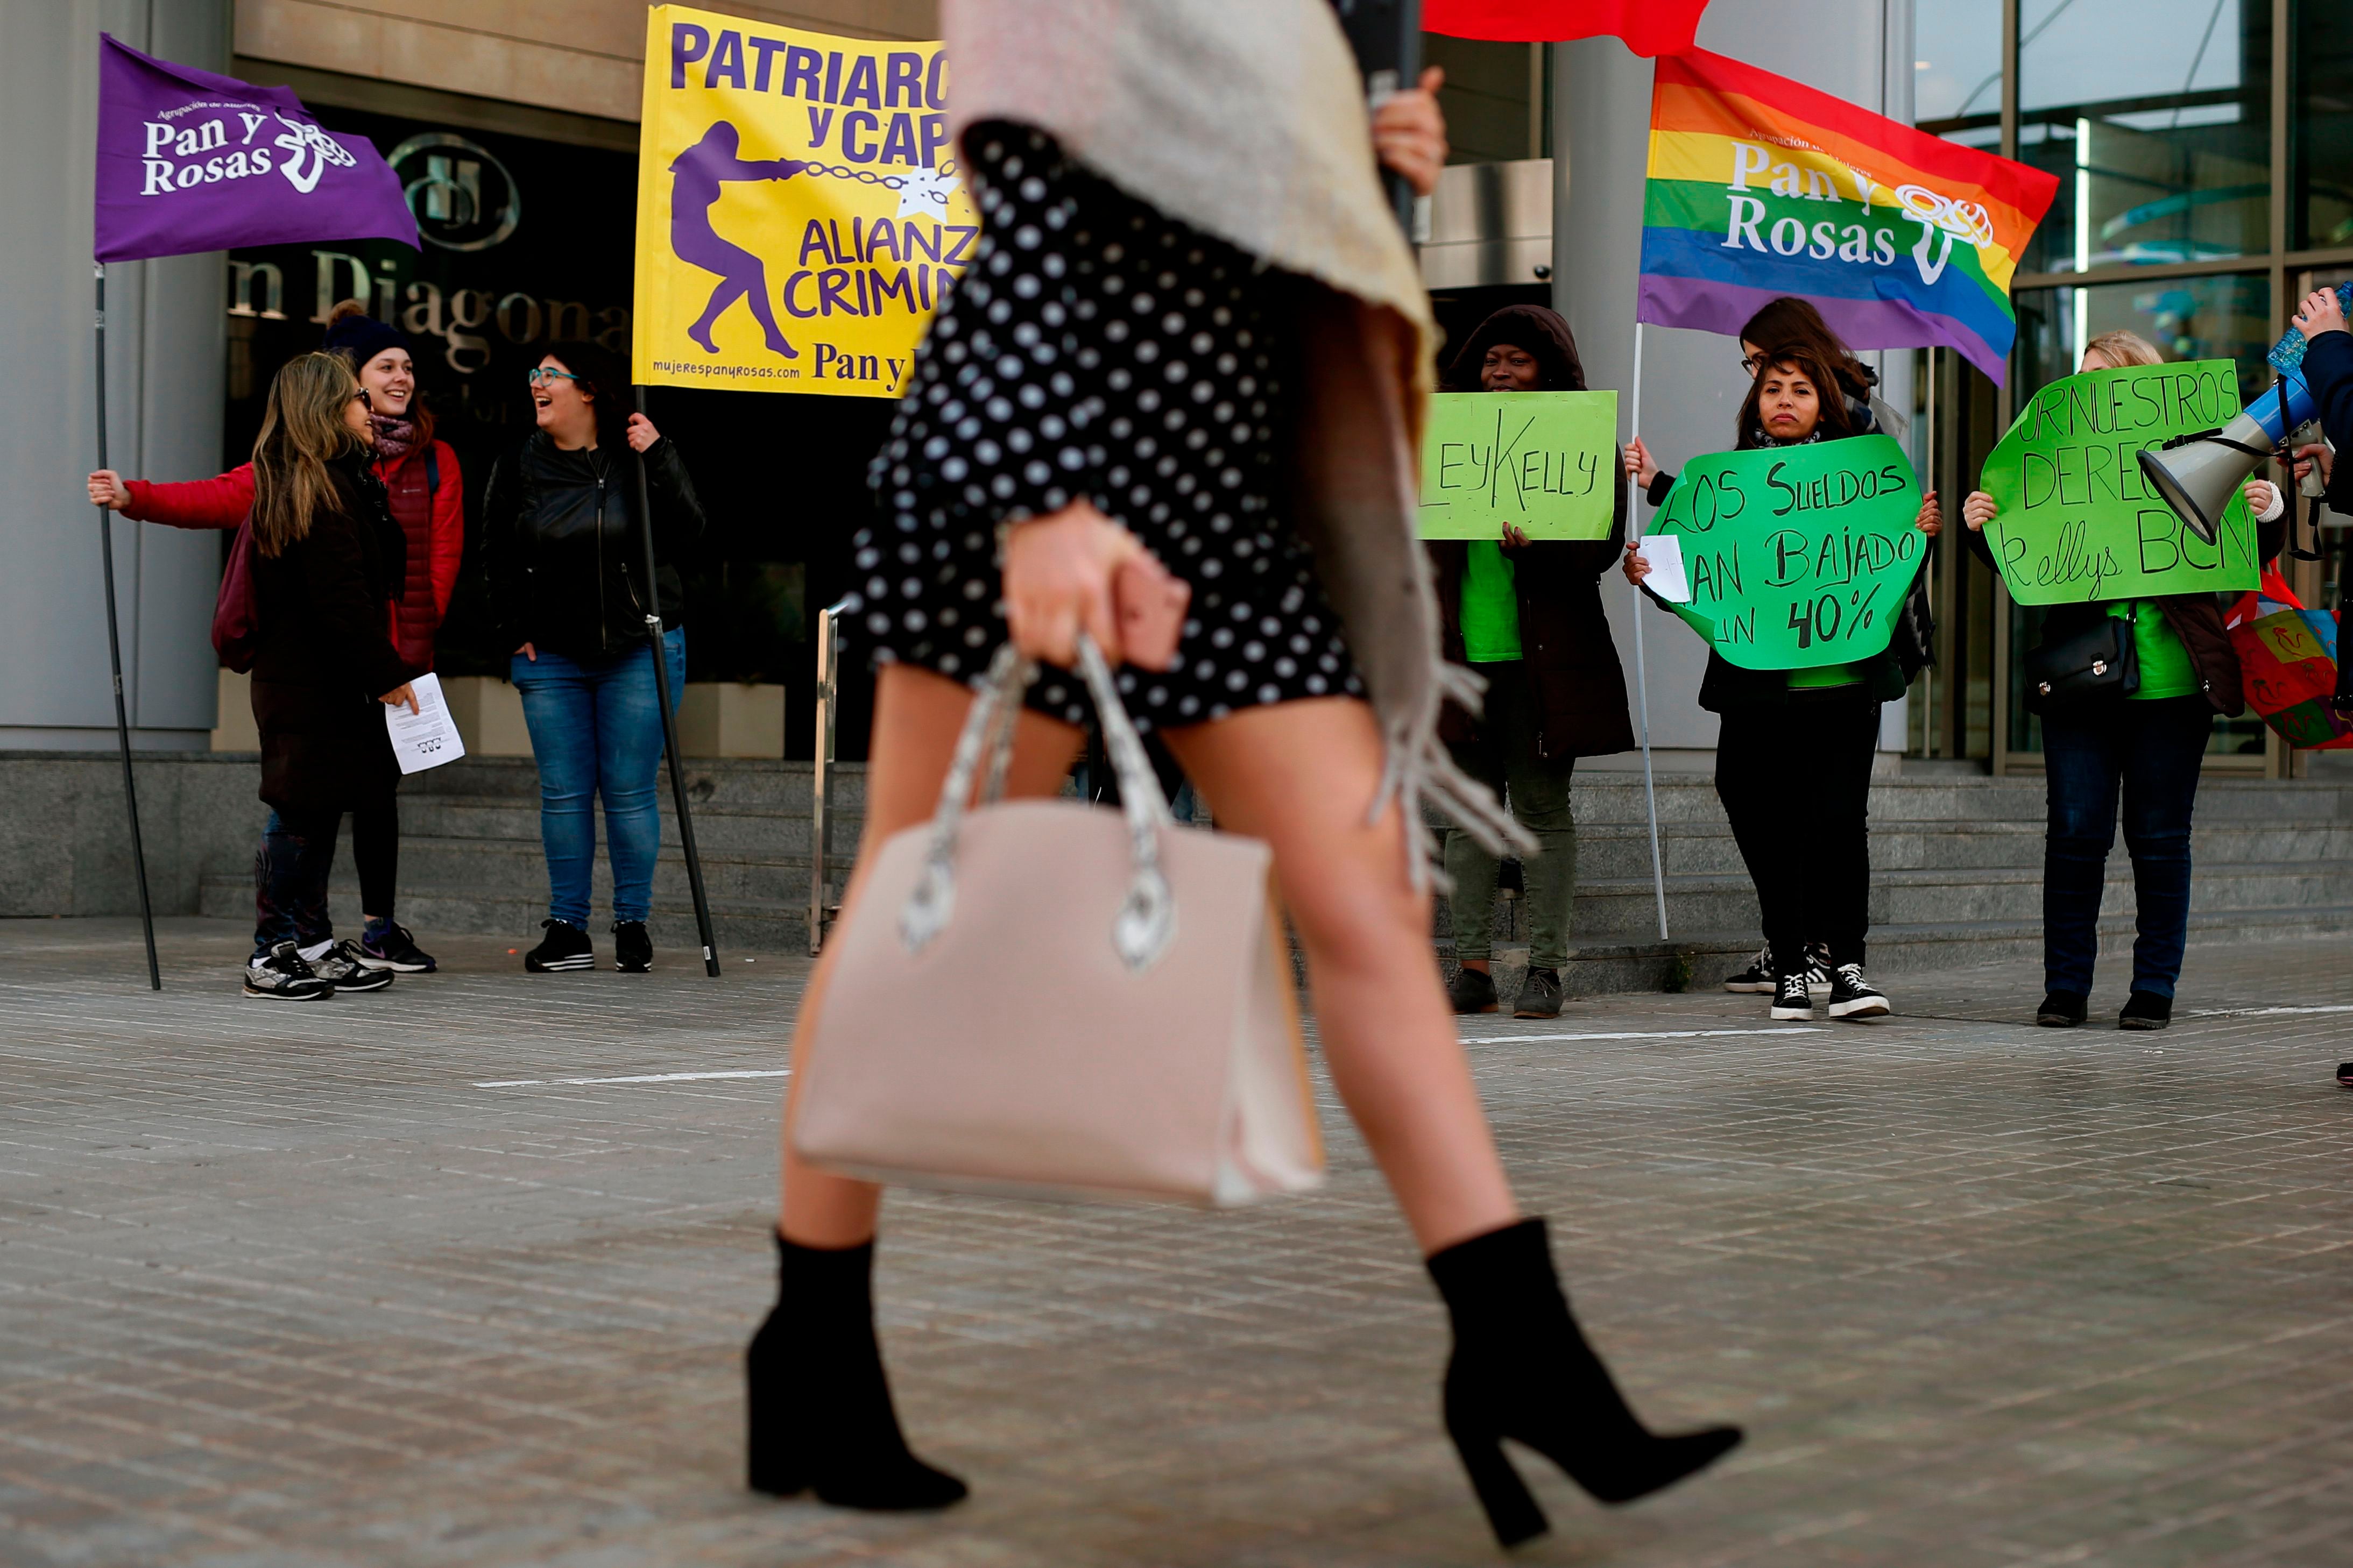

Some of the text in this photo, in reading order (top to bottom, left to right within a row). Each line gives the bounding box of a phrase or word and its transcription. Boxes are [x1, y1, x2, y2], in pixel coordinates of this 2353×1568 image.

[142, 112, 268, 159] Pan y
[842, 111, 952, 169] CAP
[139, 147, 272, 196] Rosas
[1726, 141, 1842, 203] Pan
[1849, 168, 1882, 216] y
[799, 216, 979, 267] ALIANZ
[1720, 194, 1896, 267] Rosas
[811, 342, 880, 381] Pan
[886, 358, 906, 392] y
[2137, 503, 2253, 574] BCN
[1680, 538, 1744, 608] AN
[1786, 582, 1882, 649] 40%
